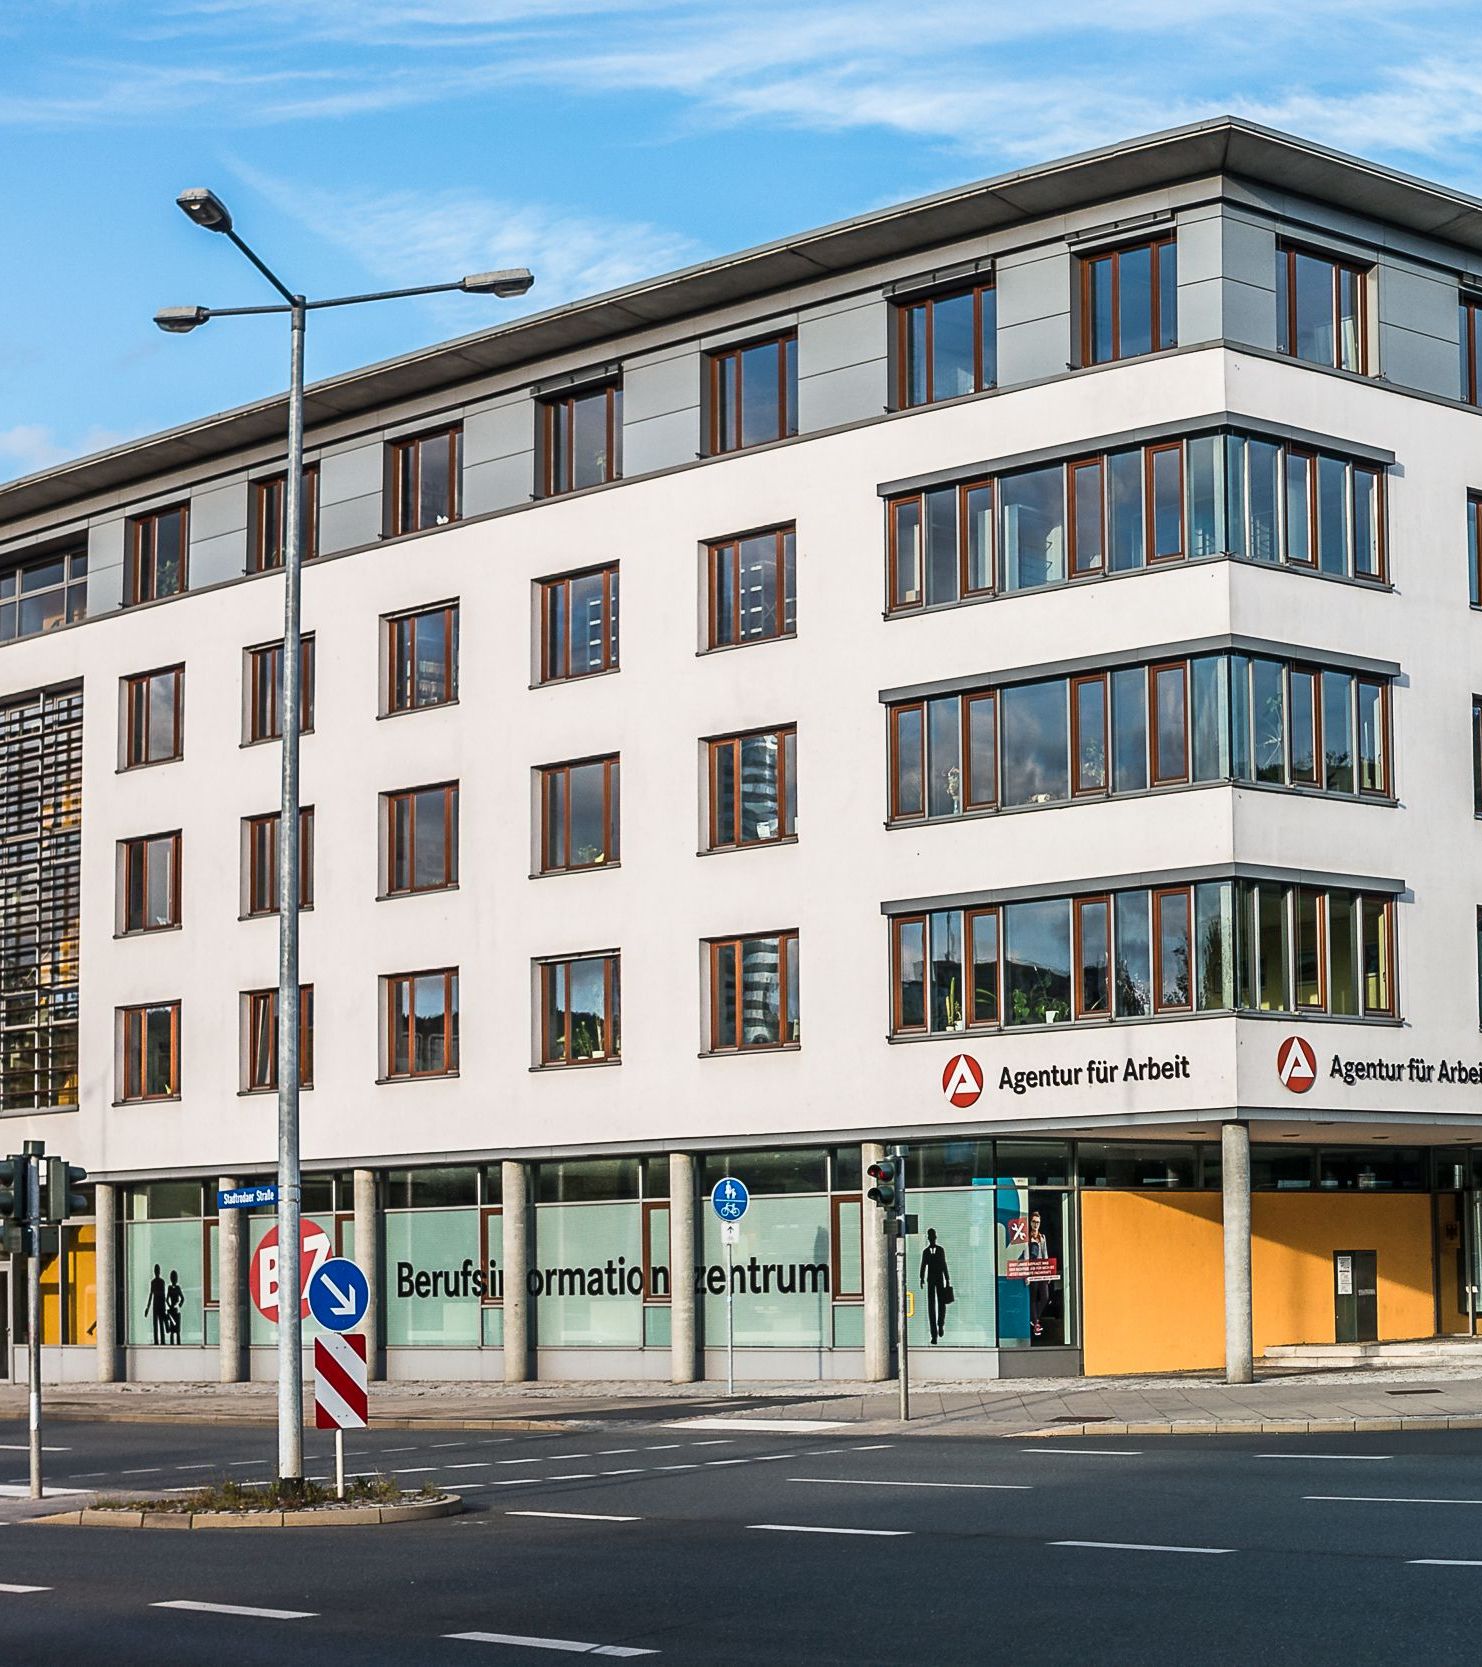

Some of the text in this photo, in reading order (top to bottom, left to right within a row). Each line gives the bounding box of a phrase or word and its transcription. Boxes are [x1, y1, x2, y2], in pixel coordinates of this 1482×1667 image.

[998, 1054, 1190, 1095] Agentur für Arbeit
[1330, 1054, 1404, 1086] Agentur
[1407, 1057, 1434, 1082] für
[223, 1189, 274, 1205] Stadtrodaer Straße
[259, 1232, 331, 1310] BZ
[397, 1256, 829, 1298] Berufsiormationzentrum
